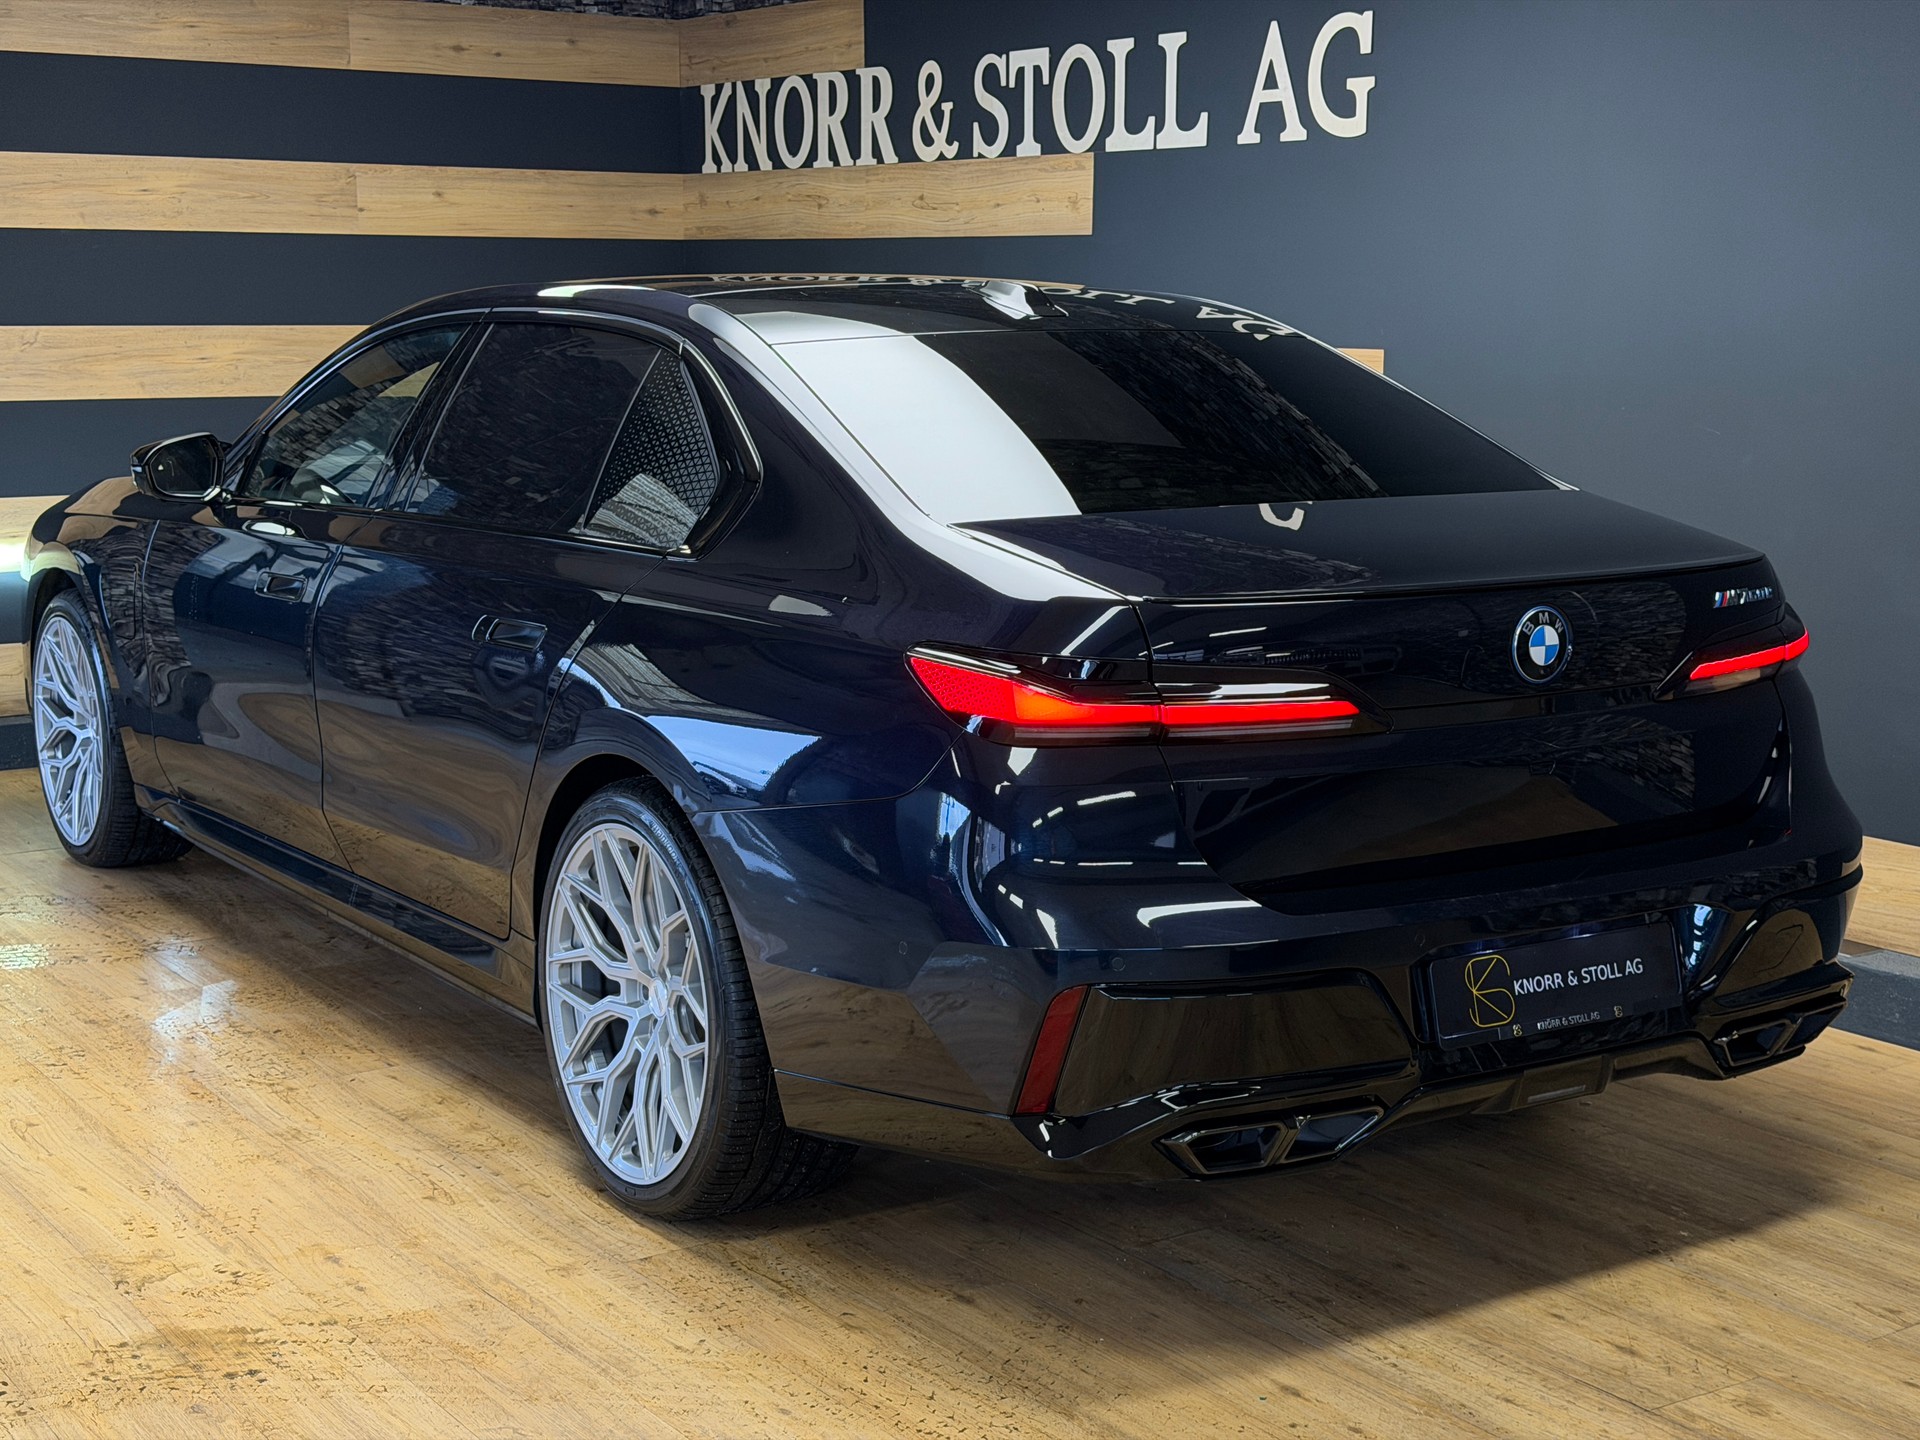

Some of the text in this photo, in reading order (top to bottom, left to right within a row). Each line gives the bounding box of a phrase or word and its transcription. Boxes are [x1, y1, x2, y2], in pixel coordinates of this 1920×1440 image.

[700, 10, 1376, 174] KNORR & STOLL AG
[1522, 611, 1564, 636] BMW
[1513, 958, 1644, 996] KNORR & STOLL AG
[1569, 1014, 1590, 1025] STOLL
[1591, 1011, 1600, 1020] AG
